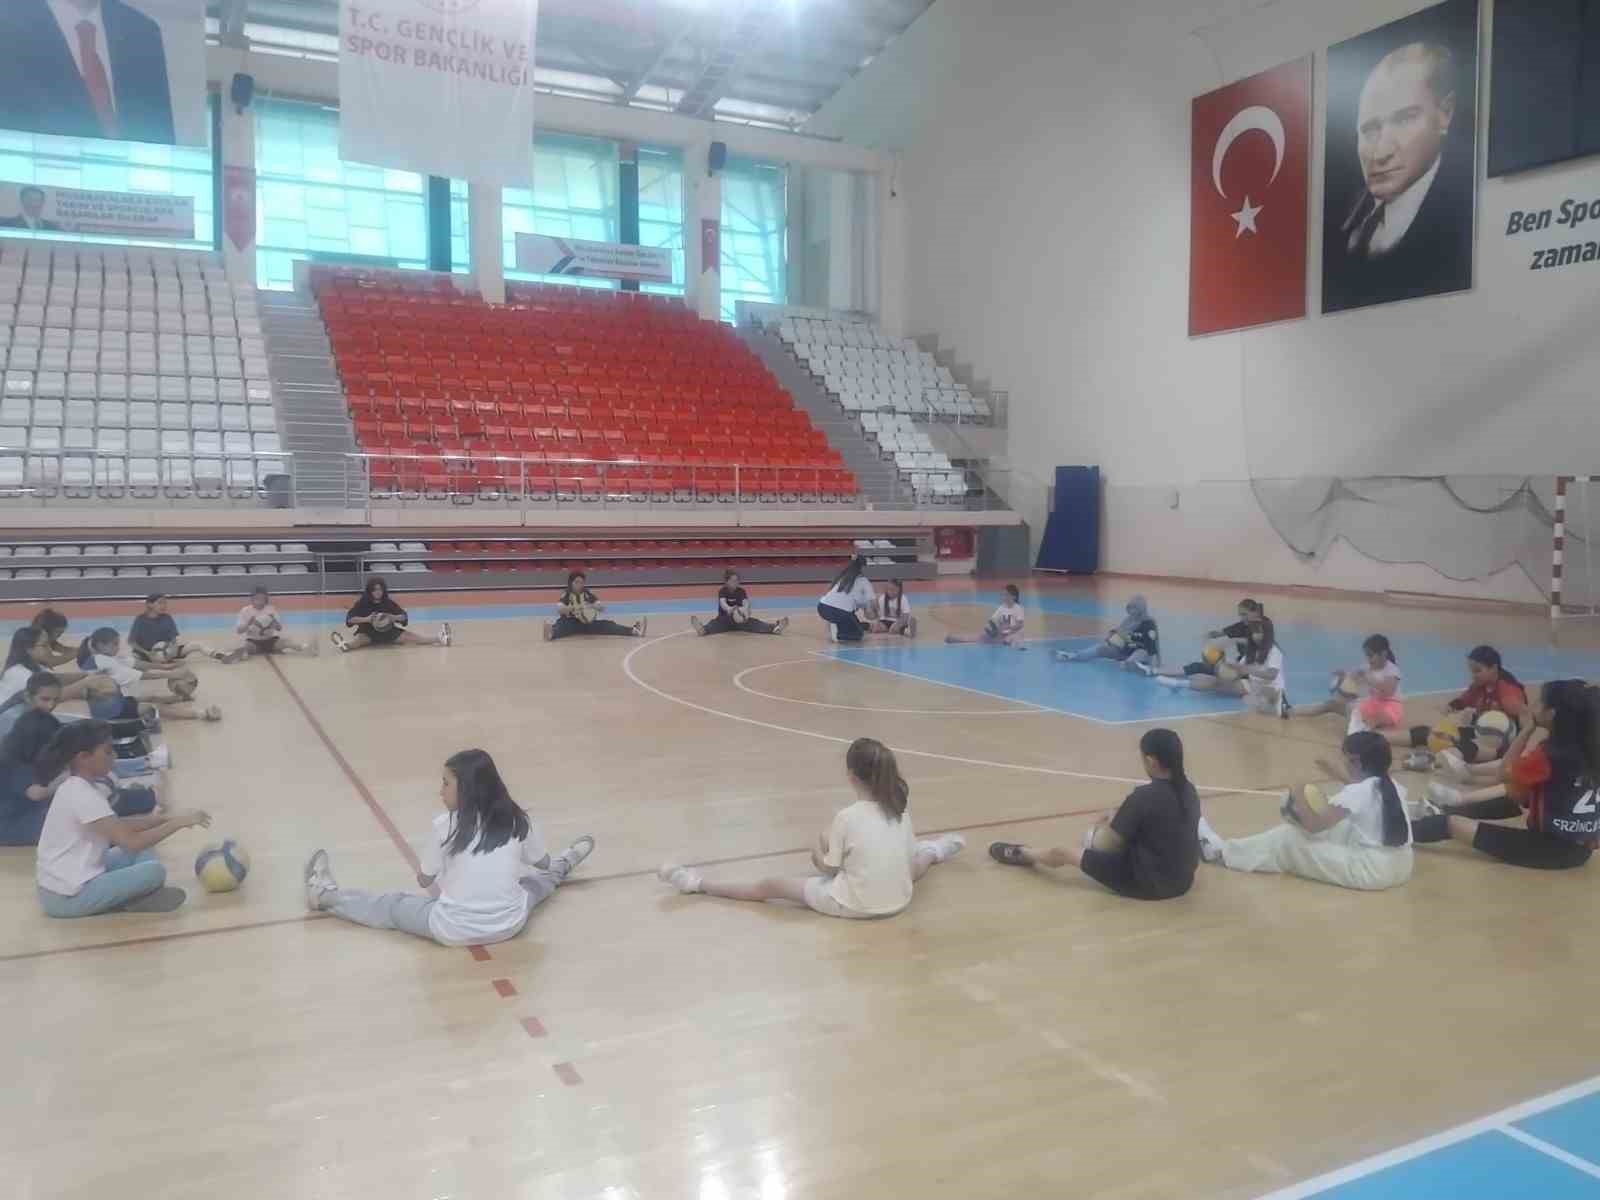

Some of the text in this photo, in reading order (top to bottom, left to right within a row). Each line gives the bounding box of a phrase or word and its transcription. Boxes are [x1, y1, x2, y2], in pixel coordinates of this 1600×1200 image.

[348, 8, 388, 34] T.C.
[503, 40, 529, 61] VE
[347, 35, 528, 86] SPOR BAKANLIĞI
[1505, 209, 1553, 236] Ben
[1530, 241, 1600, 270] zama
